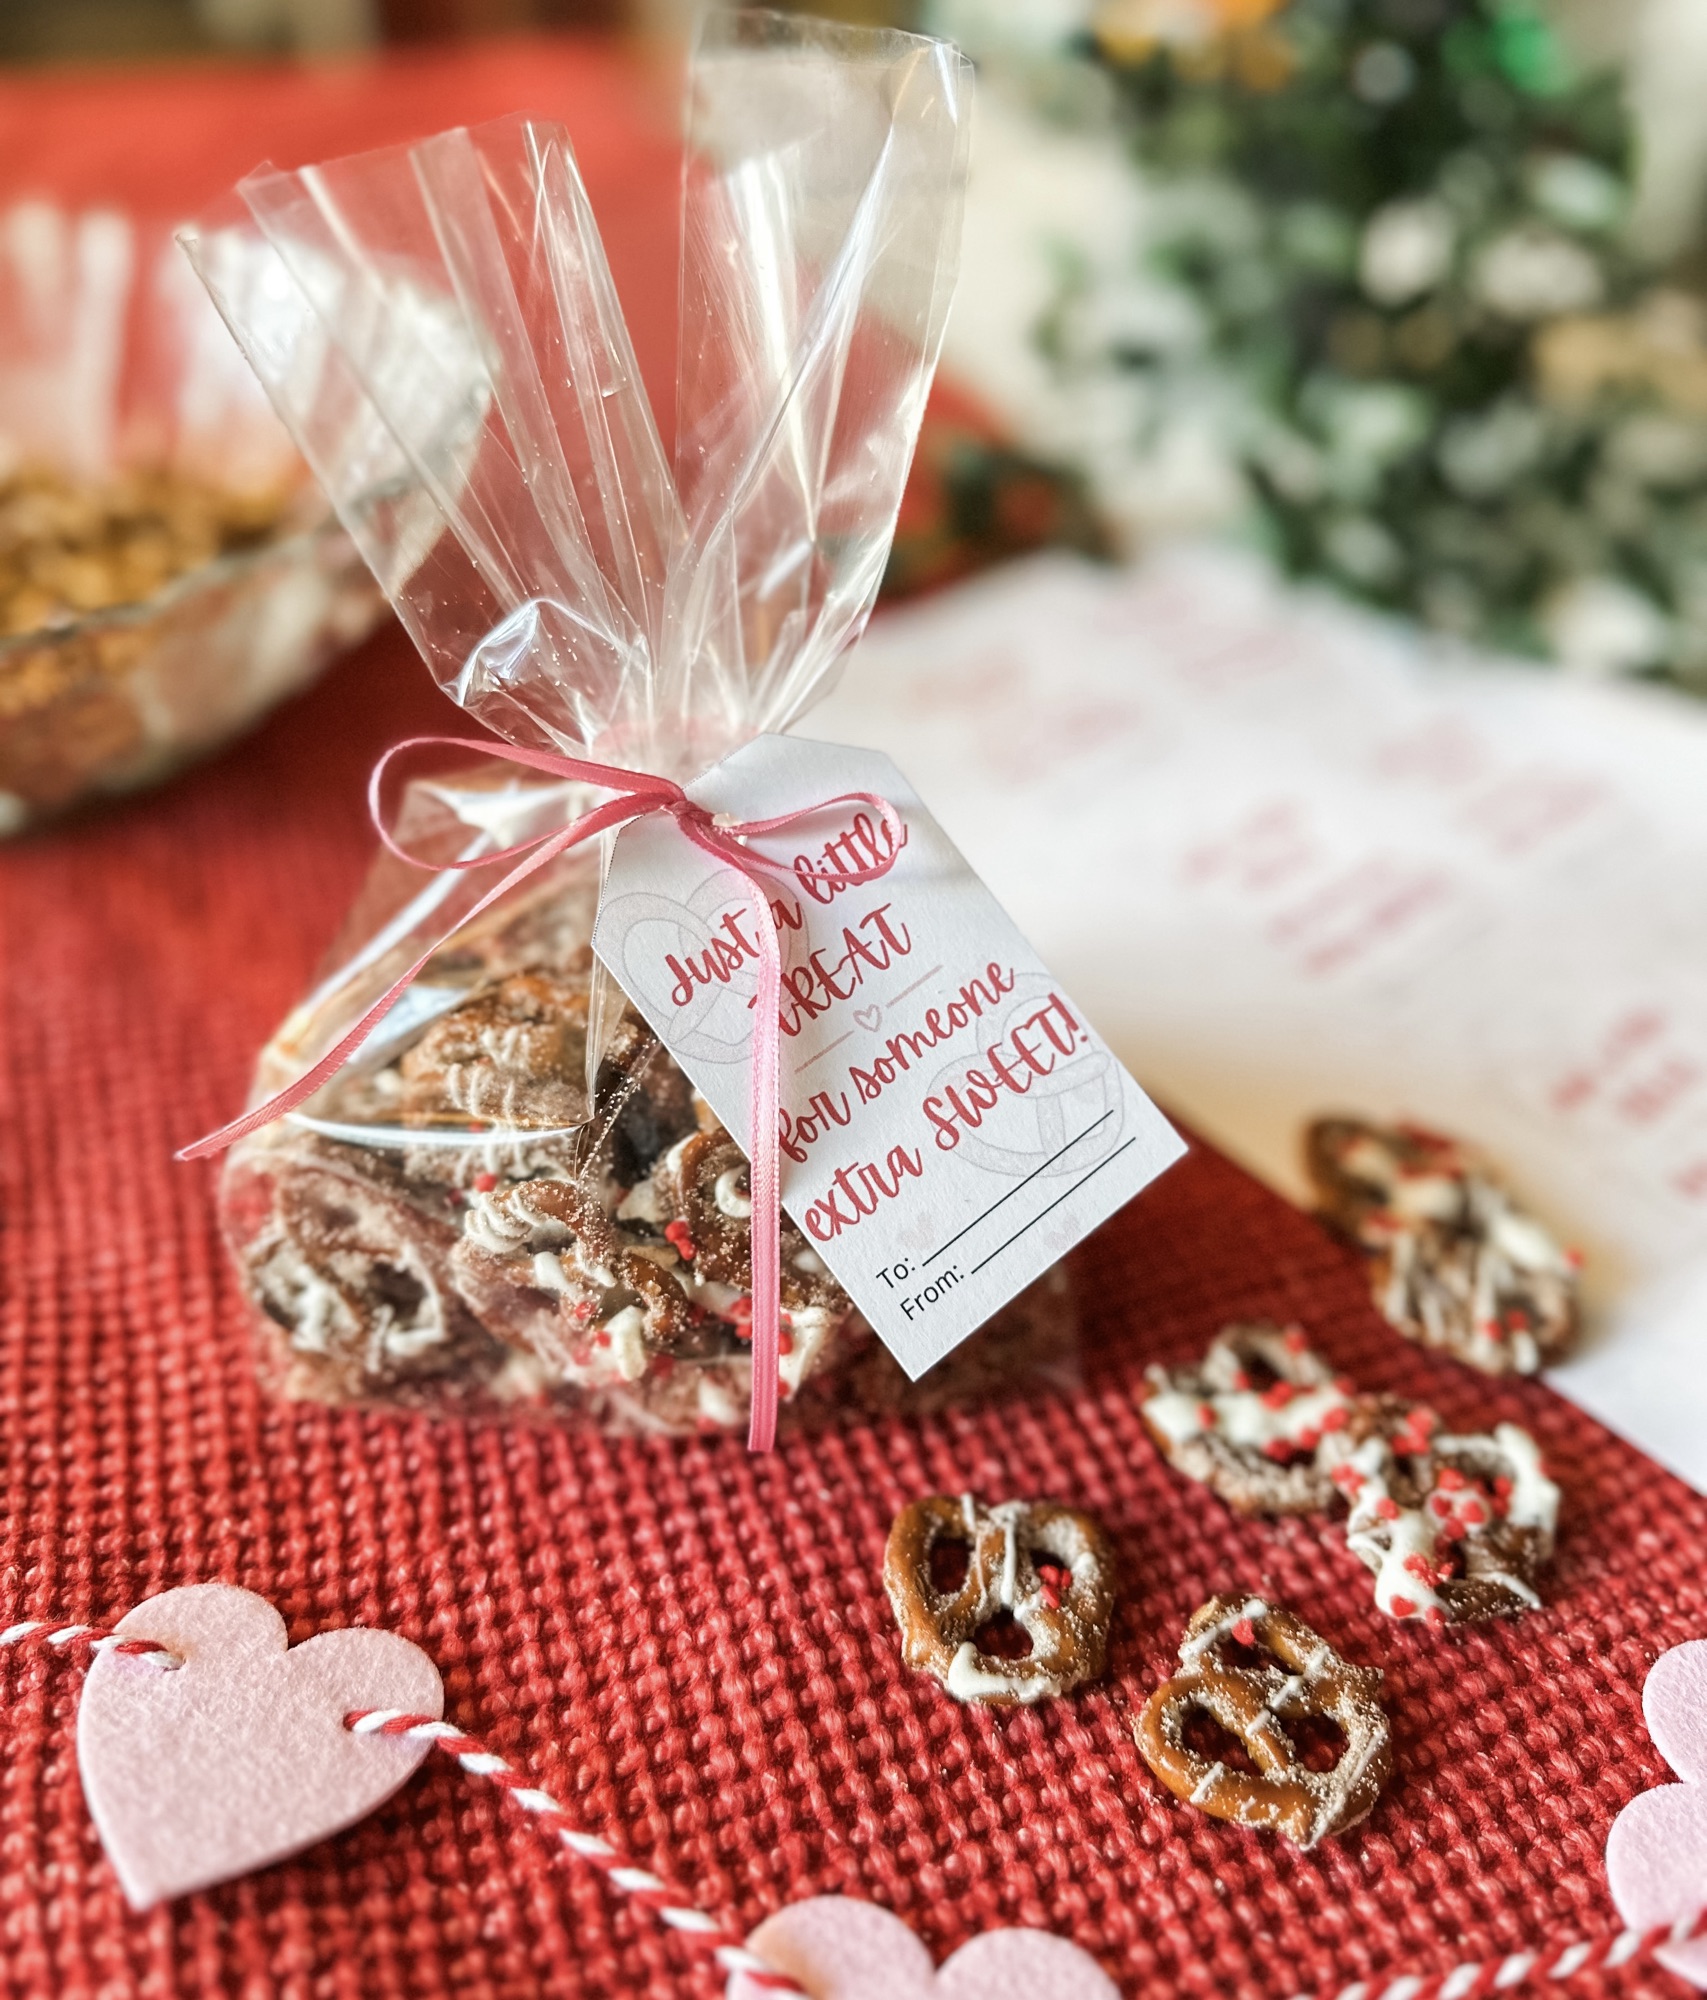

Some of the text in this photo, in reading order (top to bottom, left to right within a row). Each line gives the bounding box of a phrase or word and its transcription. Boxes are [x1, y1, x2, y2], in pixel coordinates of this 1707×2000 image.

[779, 961, 1015, 1164] for someone
[805, 992, 1089, 1242] extra SWEET!
[875, 1256, 916, 1289] To:
[900, 1265, 965, 1321] From:
